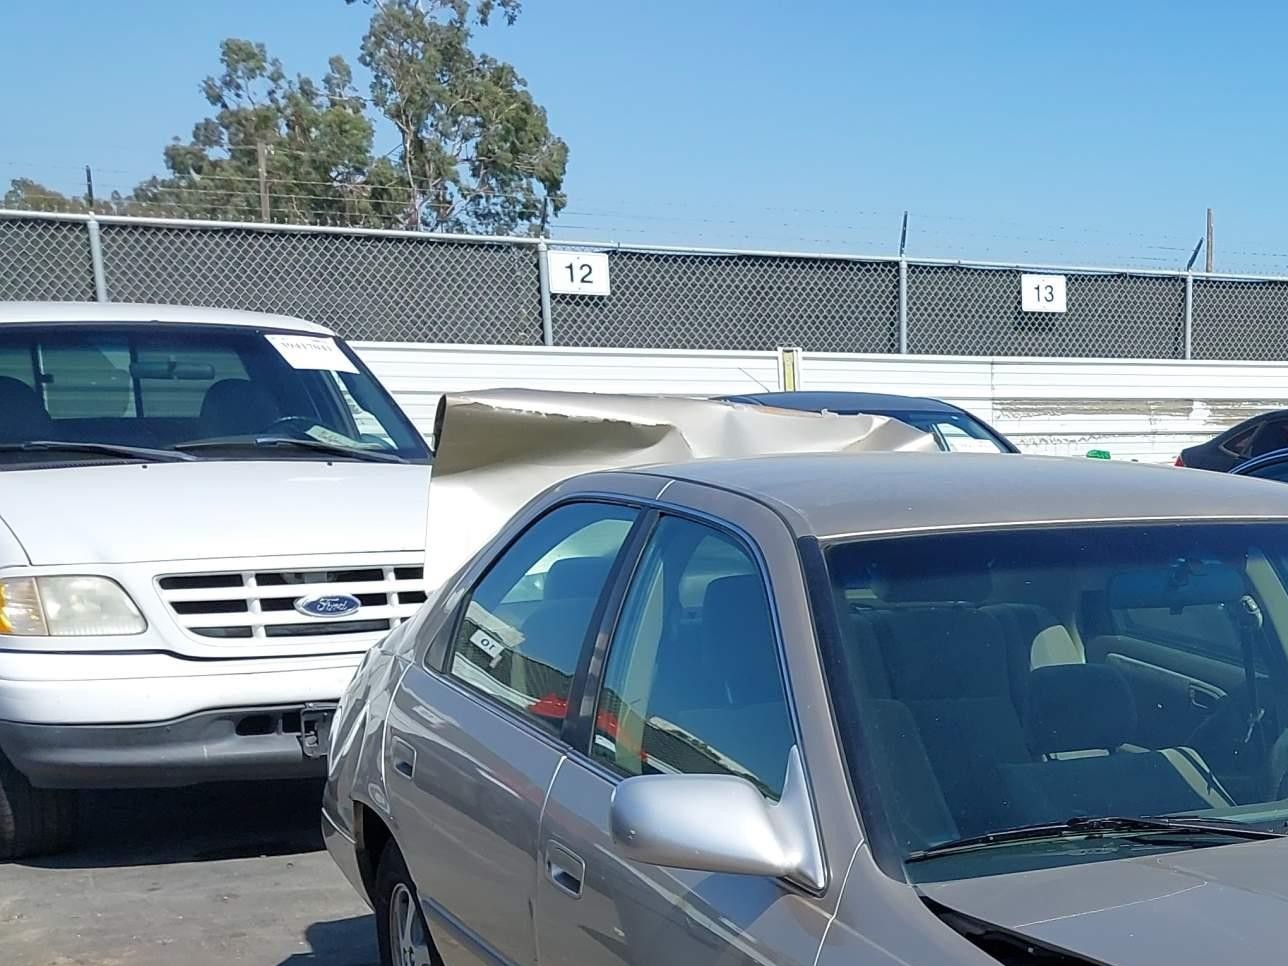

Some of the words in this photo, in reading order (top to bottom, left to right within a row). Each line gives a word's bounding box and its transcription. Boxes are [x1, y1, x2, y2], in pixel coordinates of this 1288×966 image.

[564, 262, 594, 284] 12
[1034, 284, 1054, 303] 13
[316, 598, 348, 612] Ford
